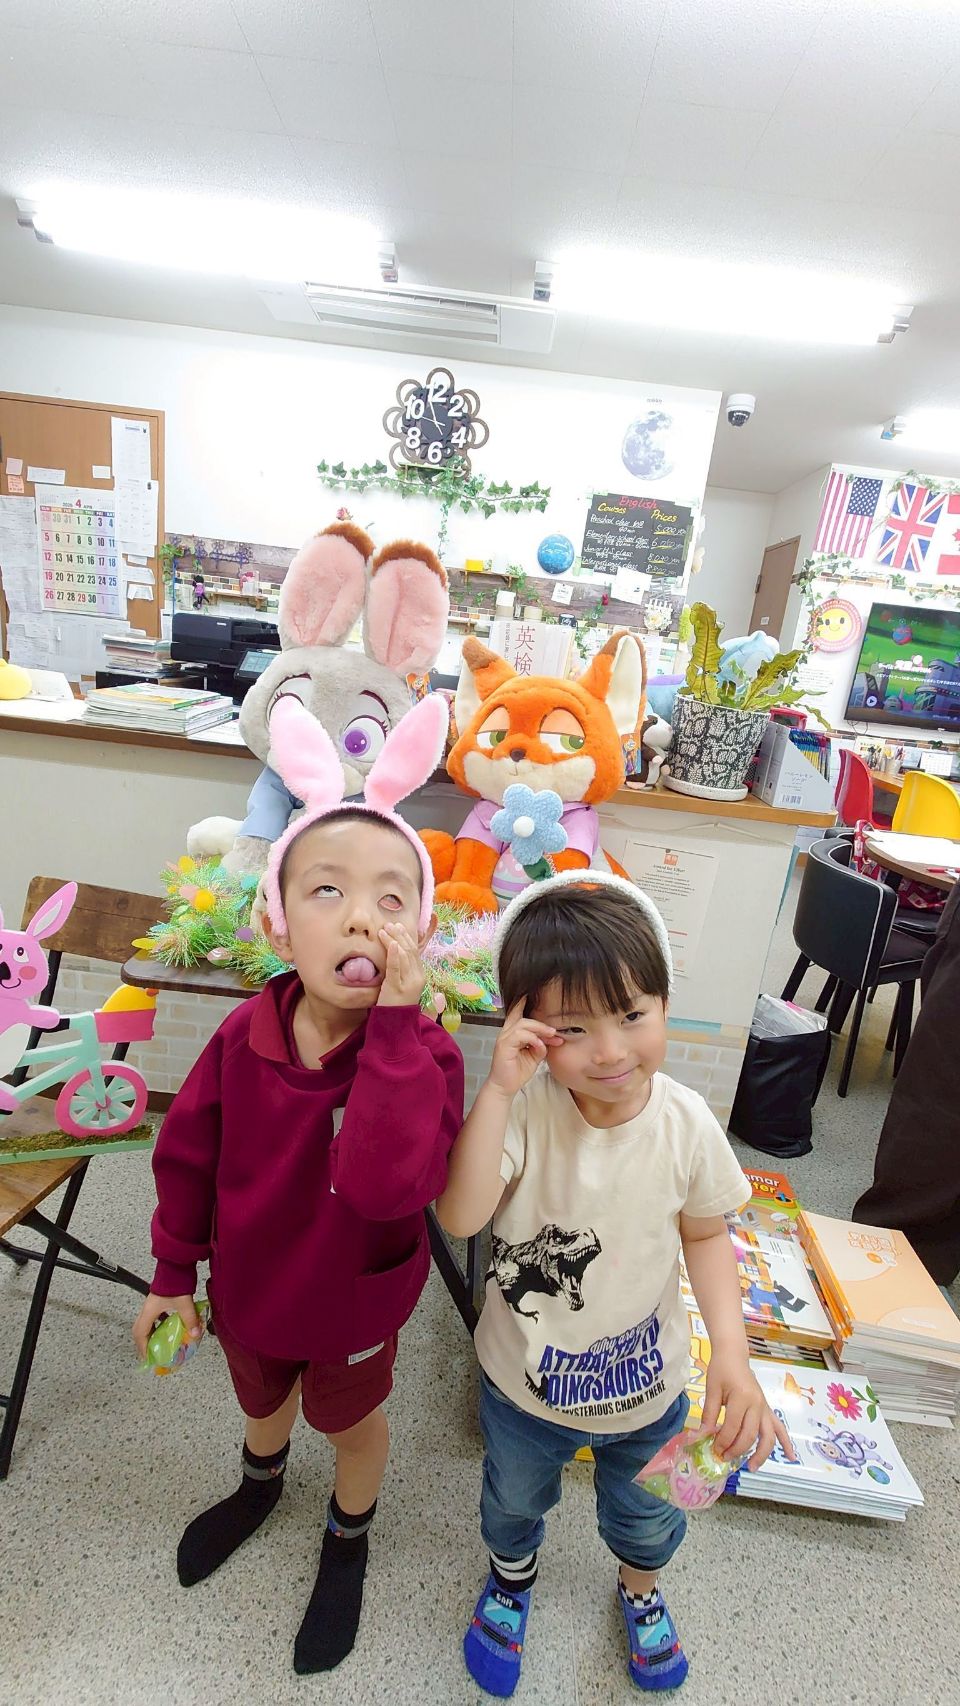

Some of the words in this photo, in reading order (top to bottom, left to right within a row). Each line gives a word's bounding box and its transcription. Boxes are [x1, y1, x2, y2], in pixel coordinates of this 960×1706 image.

[425, 382, 449, 403] 12
[404, 399, 425, 420] 10
[447, 394, 465, 417] 2
[405, 427, 421, 450] 8
[451, 426, 467, 449] 4
[428, 442, 442, 463] 6
[597, 503, 627, 514] Courses
[619, 496, 657, 509] English
[77, 516, 81, 525] 1
[87, 517, 92, 526] 2
[98, 518, 103, 527] 3
[108, 519, 114, 528] 4
[651, 509, 678, 523] Prices
[44, 533, 50, 542] 5
[55, 533, 60, 543] 6
[66, 534, 71, 544] 7
[77, 535, 82, 545] 8
[88, 536, 93, 546] 9
[97, 537, 105, 547] 10
[109, 538, 115, 548] 11
[44, 551, 52, 561] 12
[55, 553, 62, 562] 13
[66, 554, 73, 563] 14
[76, 555, 84, 565] 15
[87, 555, 95, 565] 16
[98, 557, 105, 567] 17
[108, 558, 116, 568] 18
[45, 571, 53, 581] 19
[55, 572, 64, 582] 20
[66, 573, 74, 582] 21
[76, 574, 85, 584] 22
[87, 575, 96, 585] 23
[98, 576, 107, 586] 24
[108, 577, 117, 587] 25
[45, 590, 54, 600] 26
[56, 591, 64, 601] 27
[66, 592, 75, 601] 28
[77, 593, 86, 603] 29
[87, 594, 97, 604] 30
[514, 625, 536, 677] 英検
[547, 1348, 664, 1407] DINOSAURS?
[615, 1396, 646, 1413] CHARM
[645, 1380, 667, 1402] THERE
